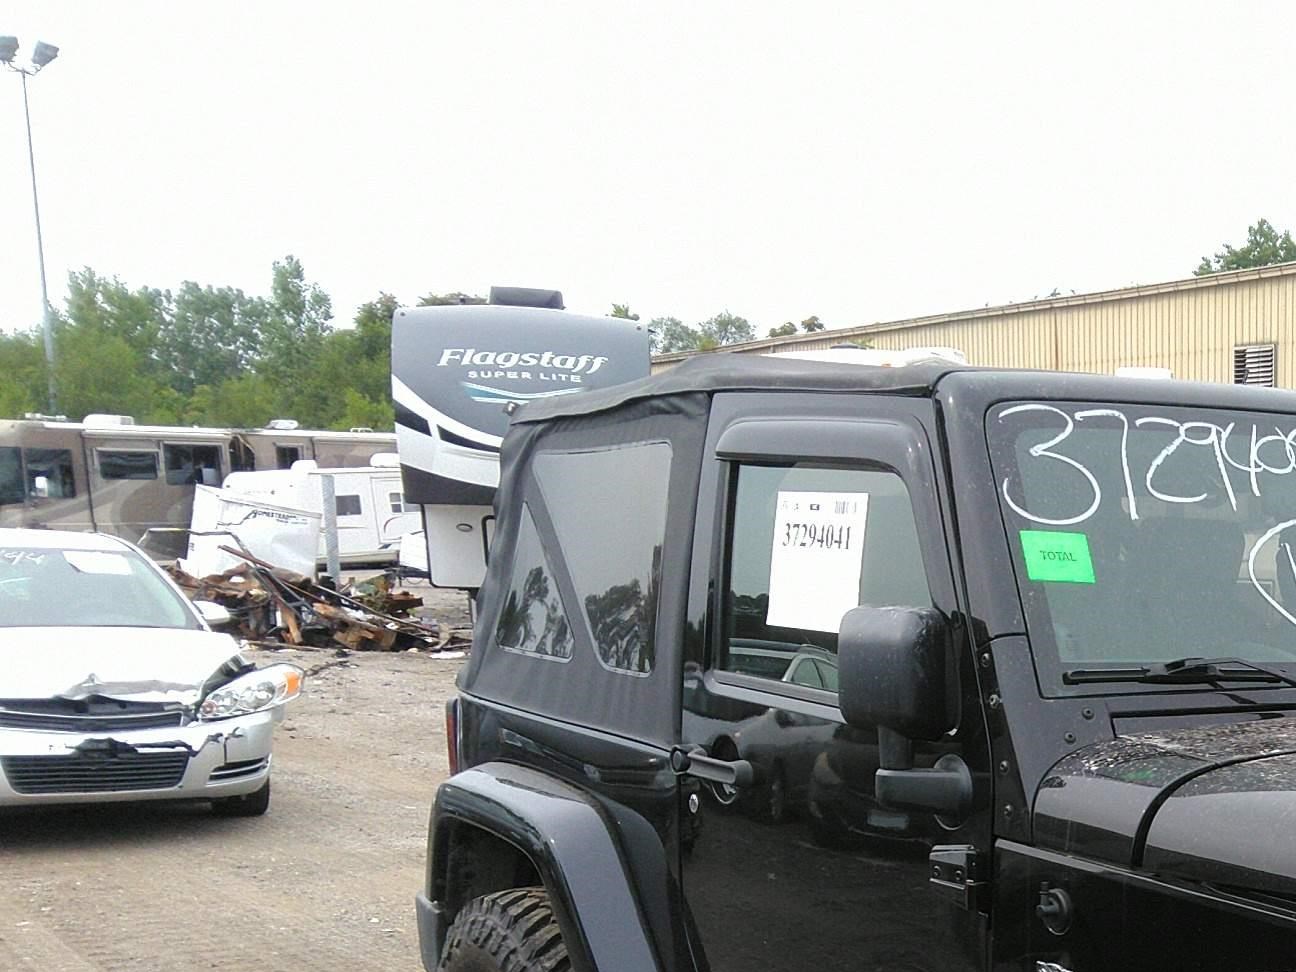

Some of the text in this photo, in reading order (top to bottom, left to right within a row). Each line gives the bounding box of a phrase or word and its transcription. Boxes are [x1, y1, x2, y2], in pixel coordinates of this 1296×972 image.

[437, 348, 608, 374] Flagstaff
[467, 370, 582, 383] SUPER LITE
[782, 522, 851, 549] 37294041
[1040, 550, 1078, 561] TOTAL
